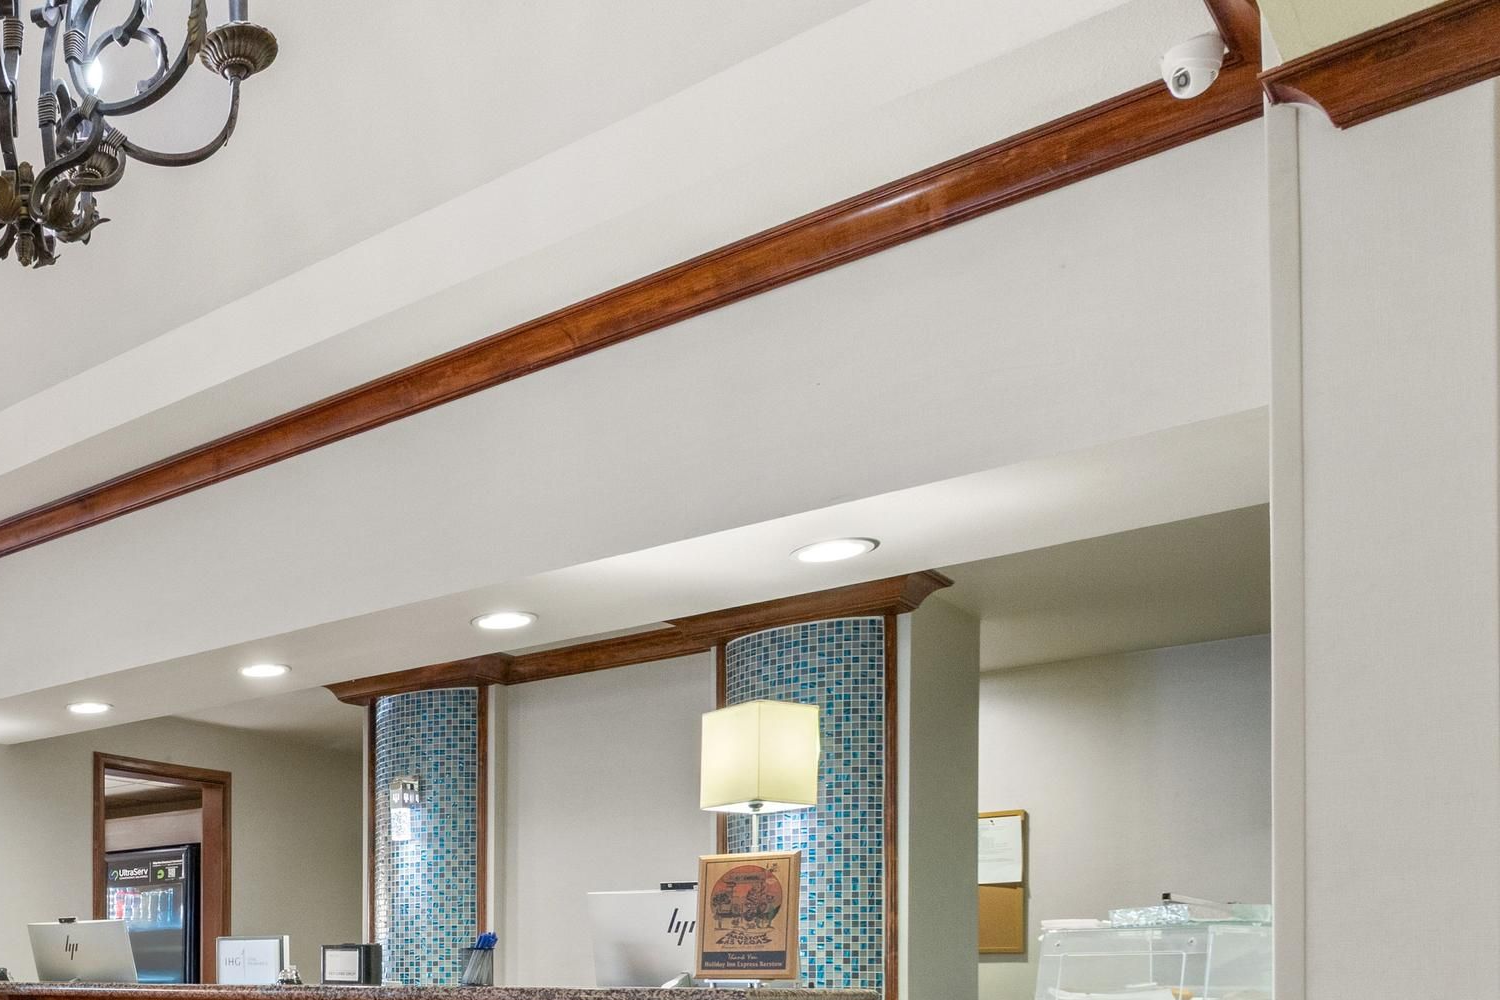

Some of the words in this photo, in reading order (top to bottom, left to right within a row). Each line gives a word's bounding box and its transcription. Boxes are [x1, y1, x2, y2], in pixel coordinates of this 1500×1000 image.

[119, 868, 149, 877] UltraServ
[667, 908, 696, 946] hp
[64, 935, 79, 960] hp
[224, 957, 241, 966] IHG
[704, 961, 725, 969] Holiday
[737, 961, 758, 969] Express
